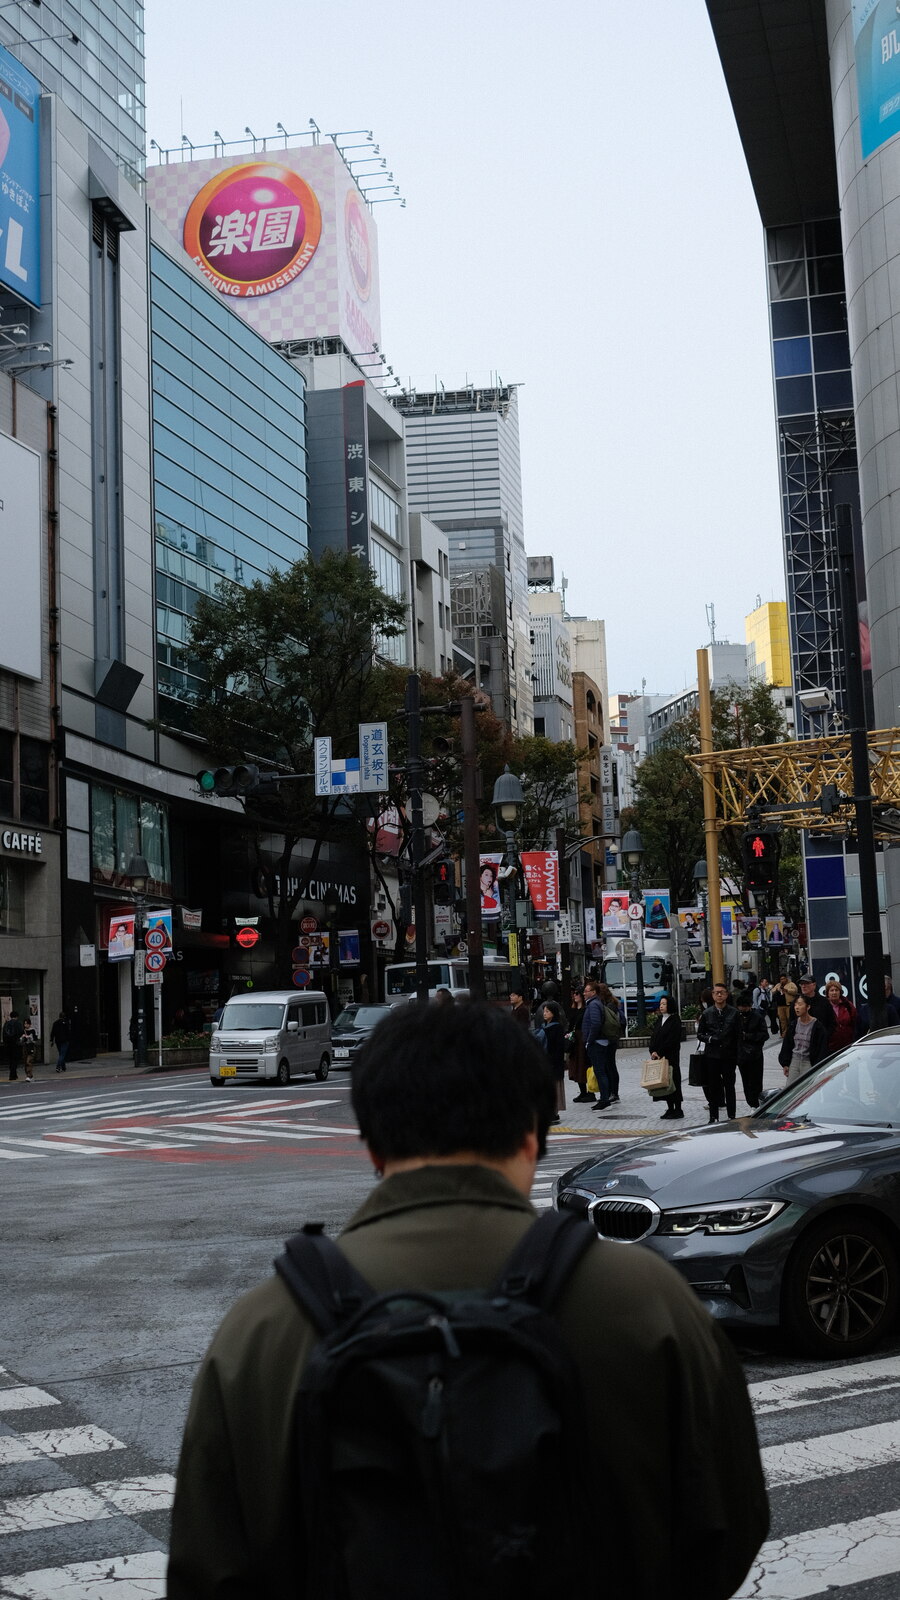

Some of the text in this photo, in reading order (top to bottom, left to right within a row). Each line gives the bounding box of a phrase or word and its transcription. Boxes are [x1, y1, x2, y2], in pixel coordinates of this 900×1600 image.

[206, 204, 299, 257] 楽園
[245, 243, 316, 297] AMUSEMENT
[318, 739, 329, 793] スクランブル式
[371, 729, 385, 786] 道玄坂下
[3, 831, 42, 854] CAFFÉ
[631, 905, 640, 917] 4
[150, 934, 162, 944] 40
